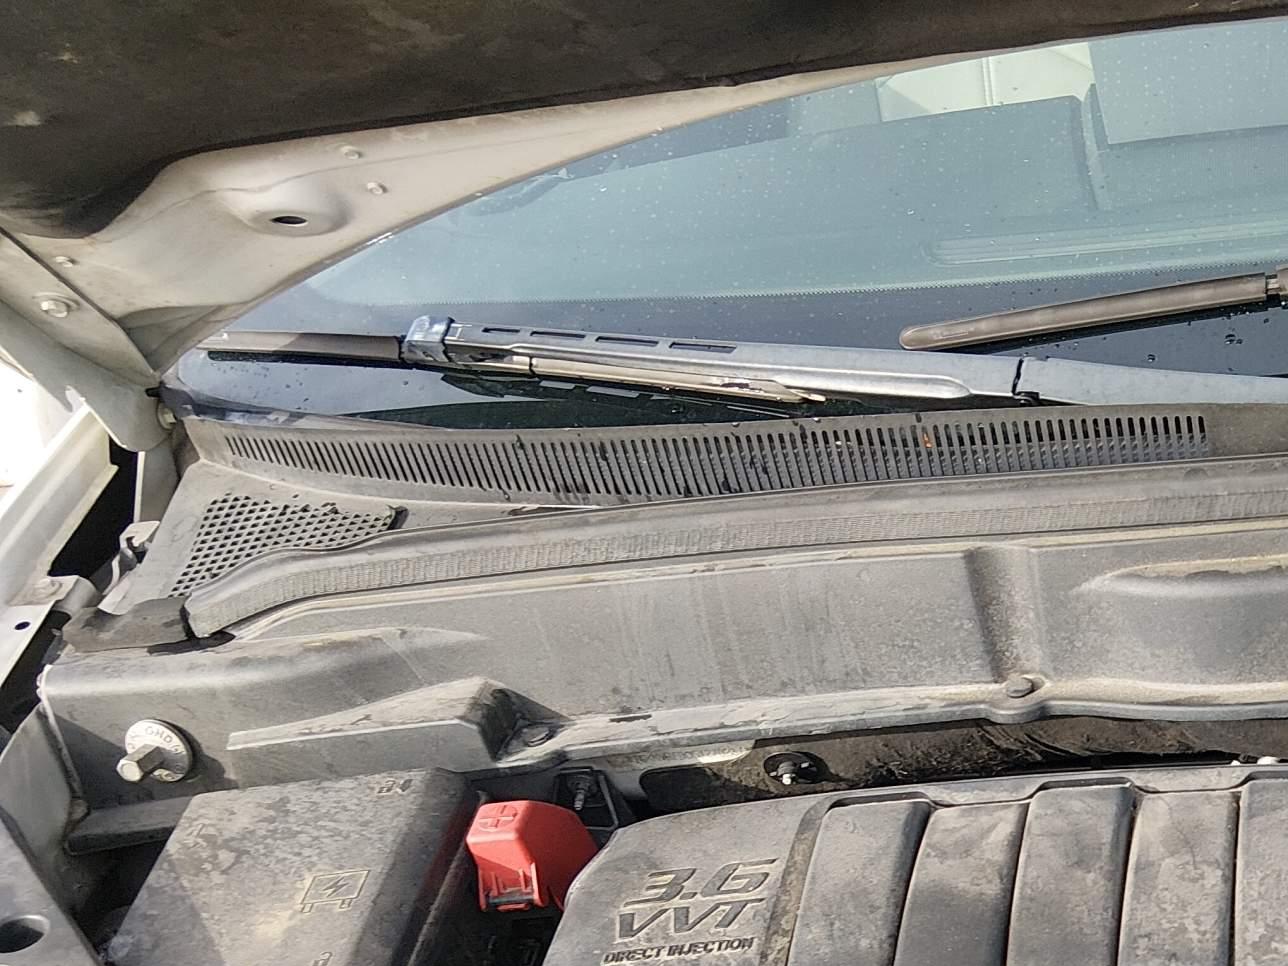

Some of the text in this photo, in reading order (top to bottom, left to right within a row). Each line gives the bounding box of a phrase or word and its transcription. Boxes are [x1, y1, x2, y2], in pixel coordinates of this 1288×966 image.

[623, 858, 778, 907] 3.6
[618, 897, 765, 939] VVT
[602, 936, 756, 964] DIRECT INJECTION
